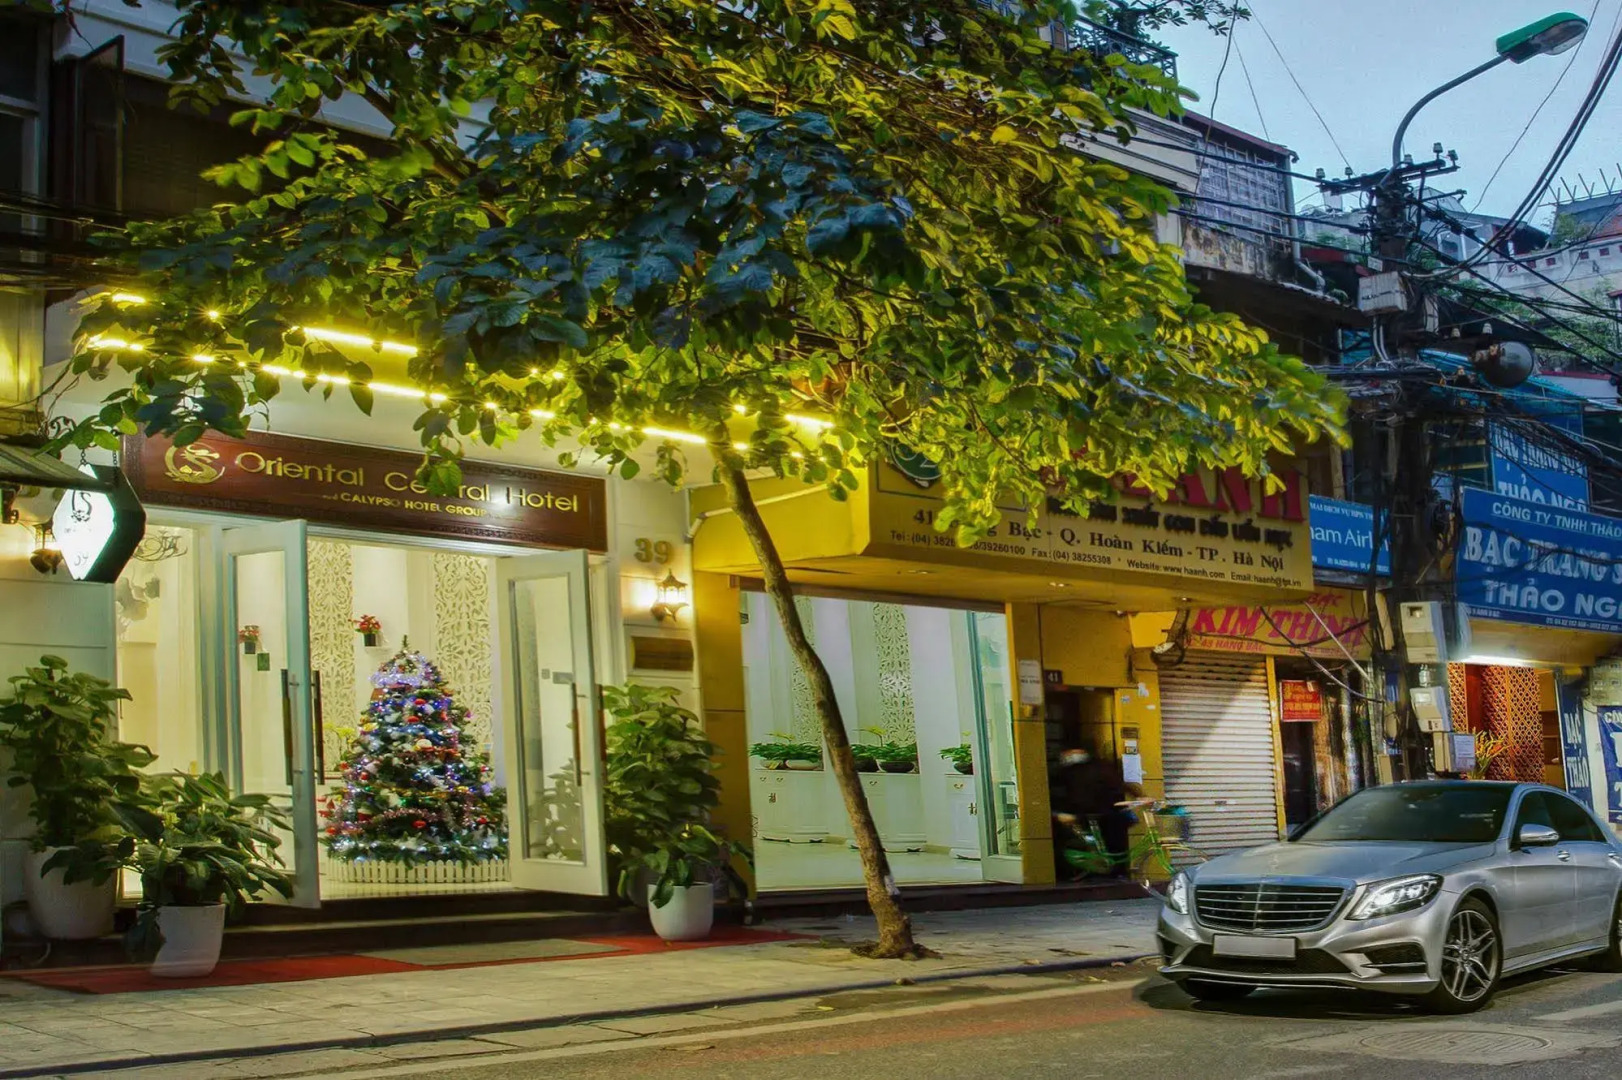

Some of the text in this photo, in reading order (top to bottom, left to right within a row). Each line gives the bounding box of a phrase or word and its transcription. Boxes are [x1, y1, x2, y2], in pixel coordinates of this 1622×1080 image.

[235, 451, 578, 513] Oriental Ceral Hotel
[340, 492, 488, 518] CALYPSO HOTEL GROUP
[1492, 501, 1531, 521] CÔNG
[1535, 510, 1551, 525] TY
[1555, 514, 1587, 532] TNHH
[634, 537, 672, 565] 39
[913, 509, 933, 526] 41
[1009, 520, 1042, 542] Bạc
[1060, 527, 1081, 545] Q.
[1089, 531, 1134, 551] Hoàn
[1142, 537, 1184, 558] Kiếm
[1233, 550, 1255, 567] Hà
[1261, 554, 1285, 573] Nội
[1463, 526, 1521, 573] BẠC
[1483, 577, 1622, 620] THẢO NG
[1193, 606, 1260, 639] KIM
[1047, 672, 1059, 682] 41
